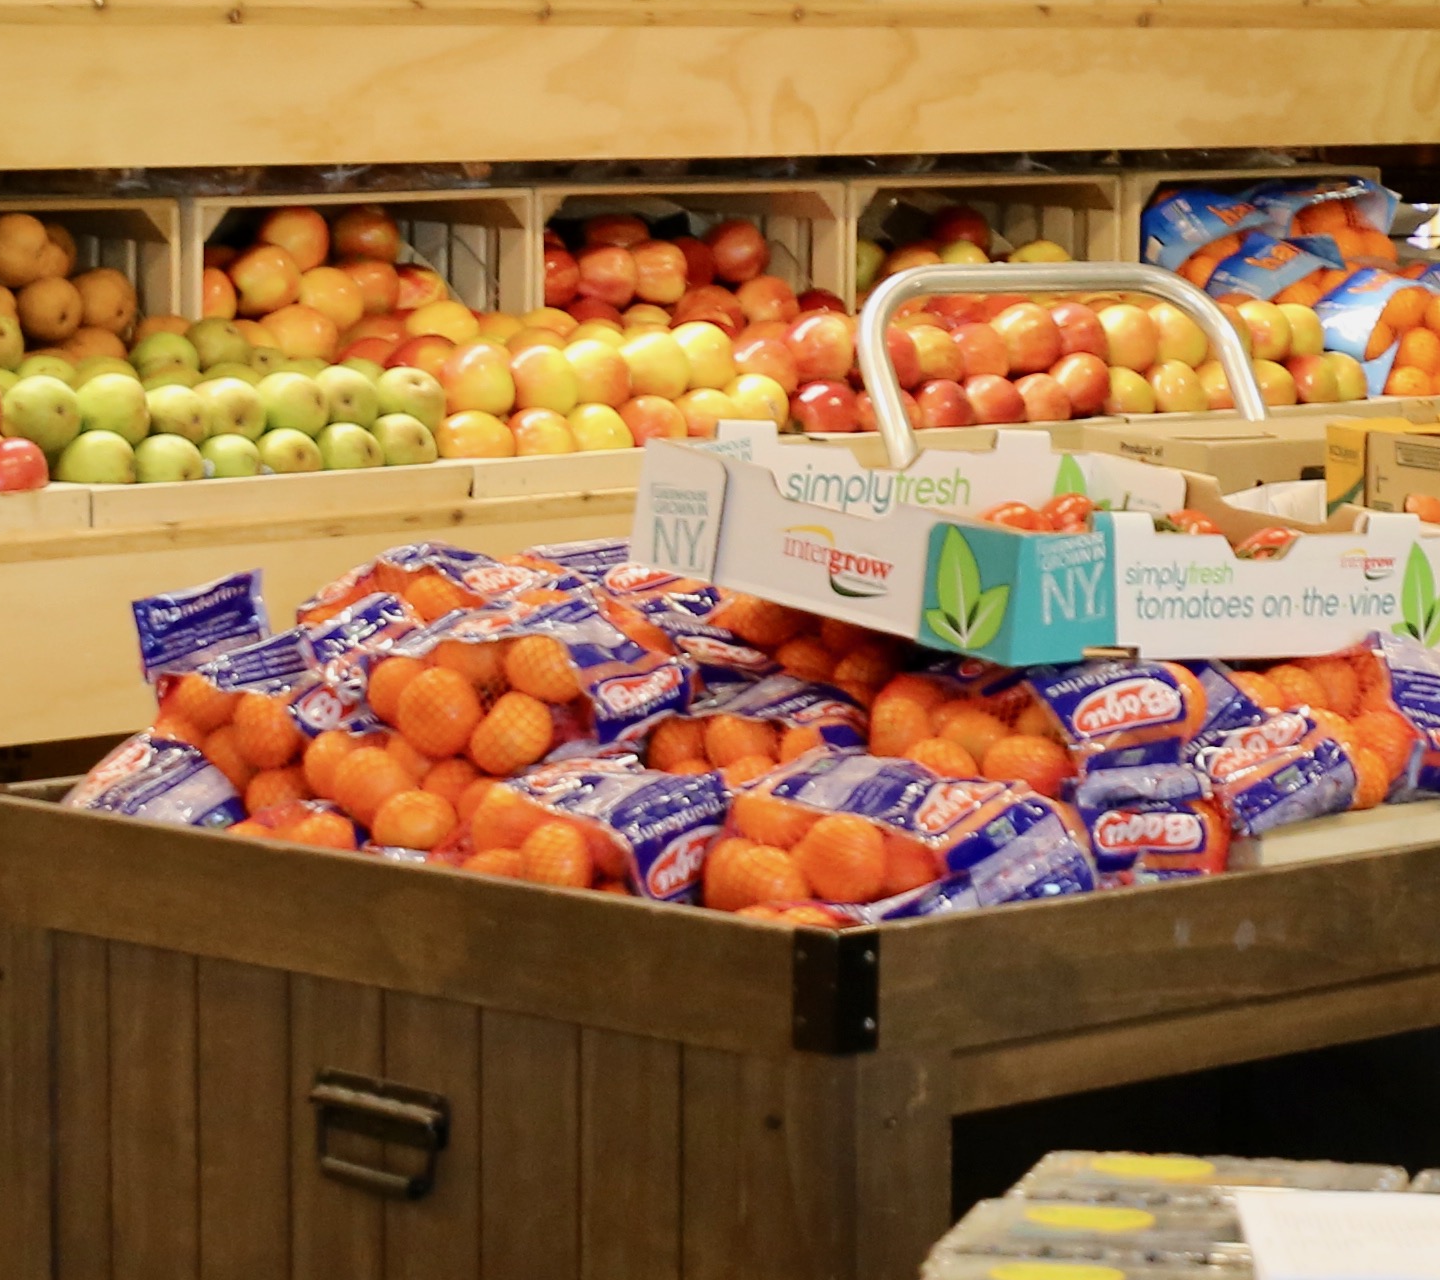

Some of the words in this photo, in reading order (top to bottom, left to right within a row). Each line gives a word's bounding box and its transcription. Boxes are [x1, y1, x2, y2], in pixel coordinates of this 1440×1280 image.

[786, 464, 971, 514] simplyfresh
[782, 530, 894, 580] intergrow
[1125, 560, 1234, 591] simplyfresh
[1137, 587, 1254, 620] tomatoes
